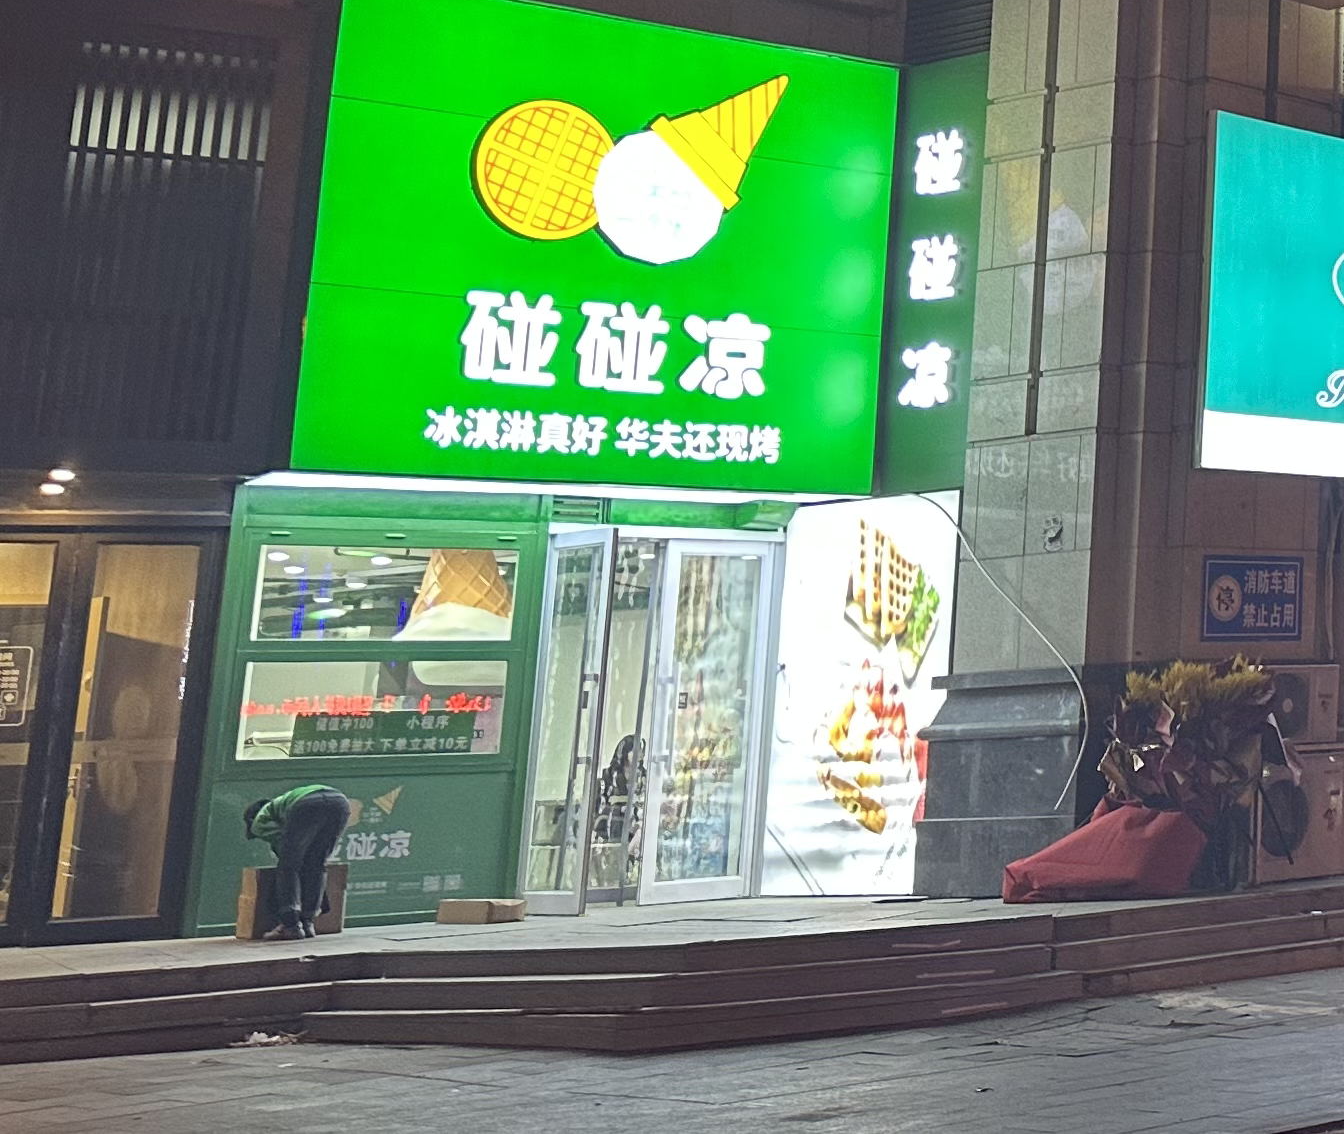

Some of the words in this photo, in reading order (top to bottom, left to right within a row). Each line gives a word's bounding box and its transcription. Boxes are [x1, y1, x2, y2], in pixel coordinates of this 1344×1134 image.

[898, 129, 968, 411] 碰碰凉
[459, 289, 772, 402] 碰碰凉
[424, 405, 609, 458] 冰淇淋真好
[615, 417, 781, 466] 华夫还现烤
[1244, 569, 1296, 595] 消防车道
[1216, 585, 1235, 612] 停
[1243, 603, 1295, 628] 禁止占用
[406, 715, 450, 732] 小程序
